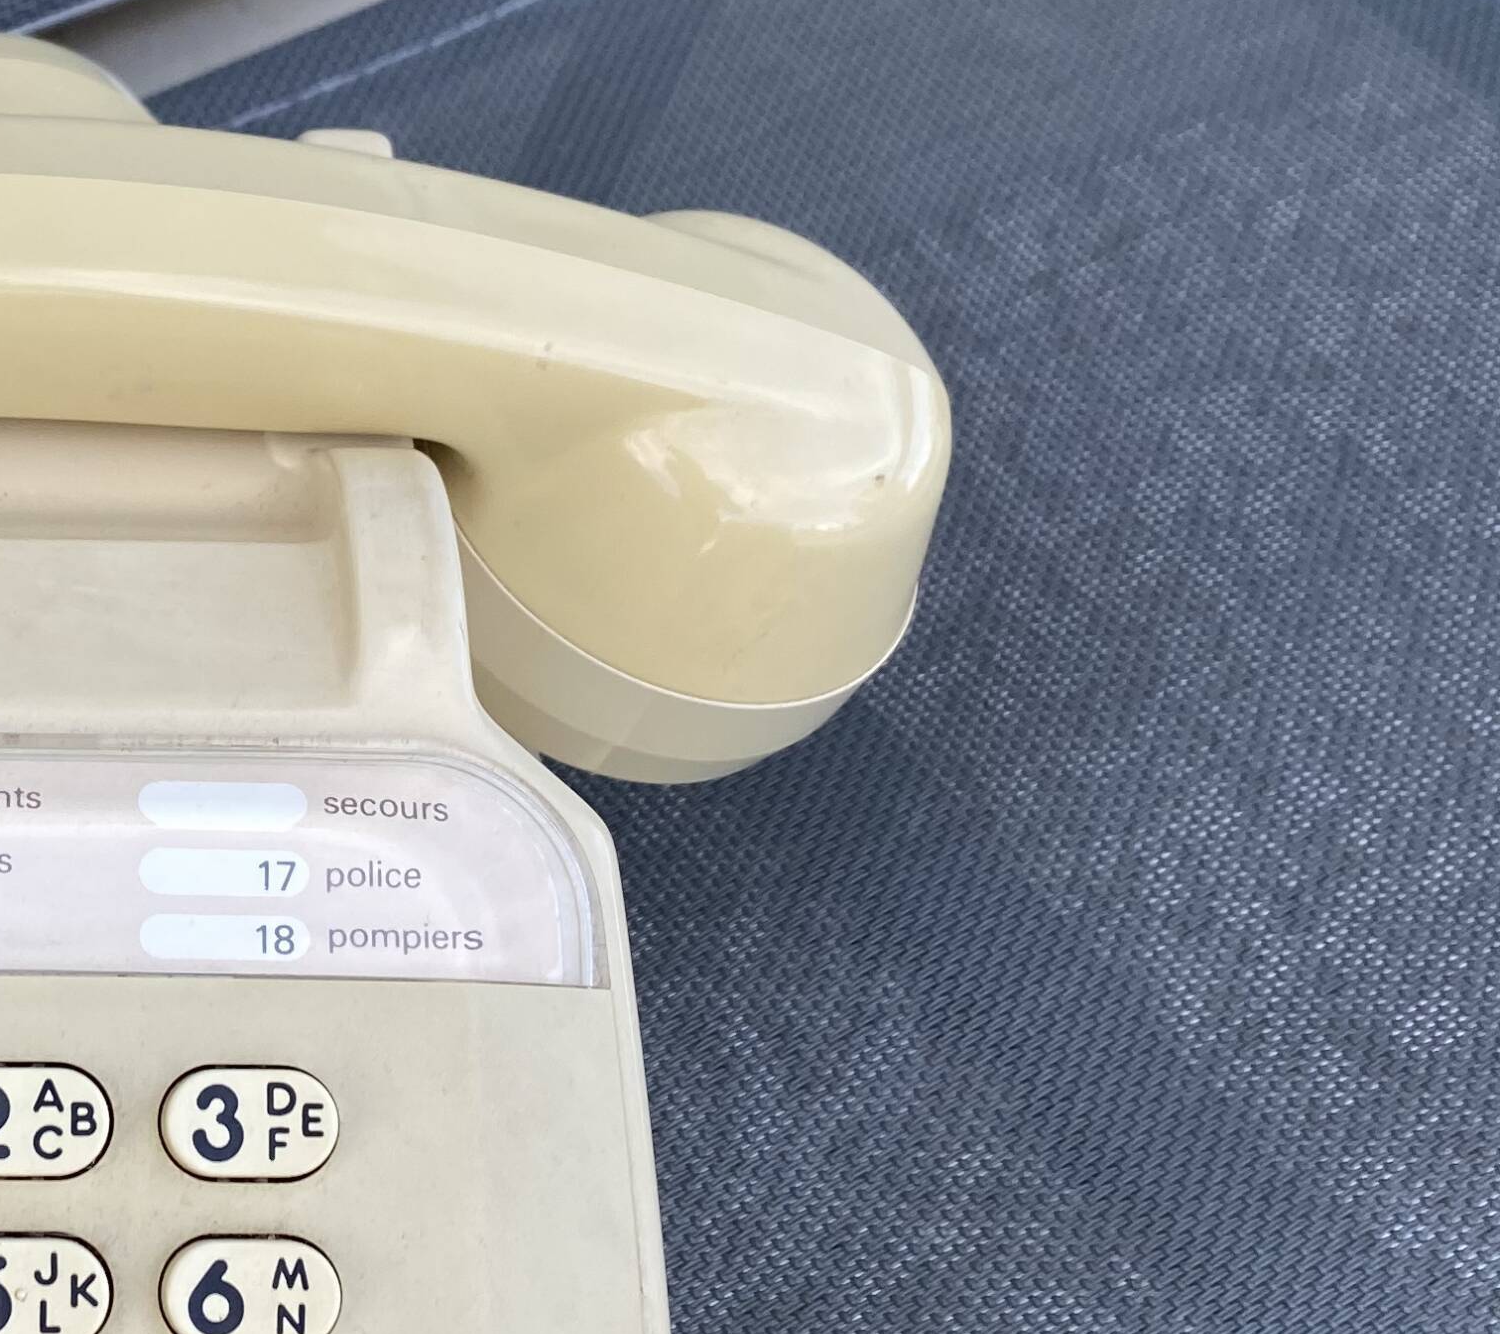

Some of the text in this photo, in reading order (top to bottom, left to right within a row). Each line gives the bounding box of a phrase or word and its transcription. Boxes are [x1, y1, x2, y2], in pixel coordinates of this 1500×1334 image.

[323, 795, 449, 822] secours
[258, 855, 422, 894] 17 police
[255, 923, 484, 956] 18 pompiers
[192, 1084, 244, 1162] 3
